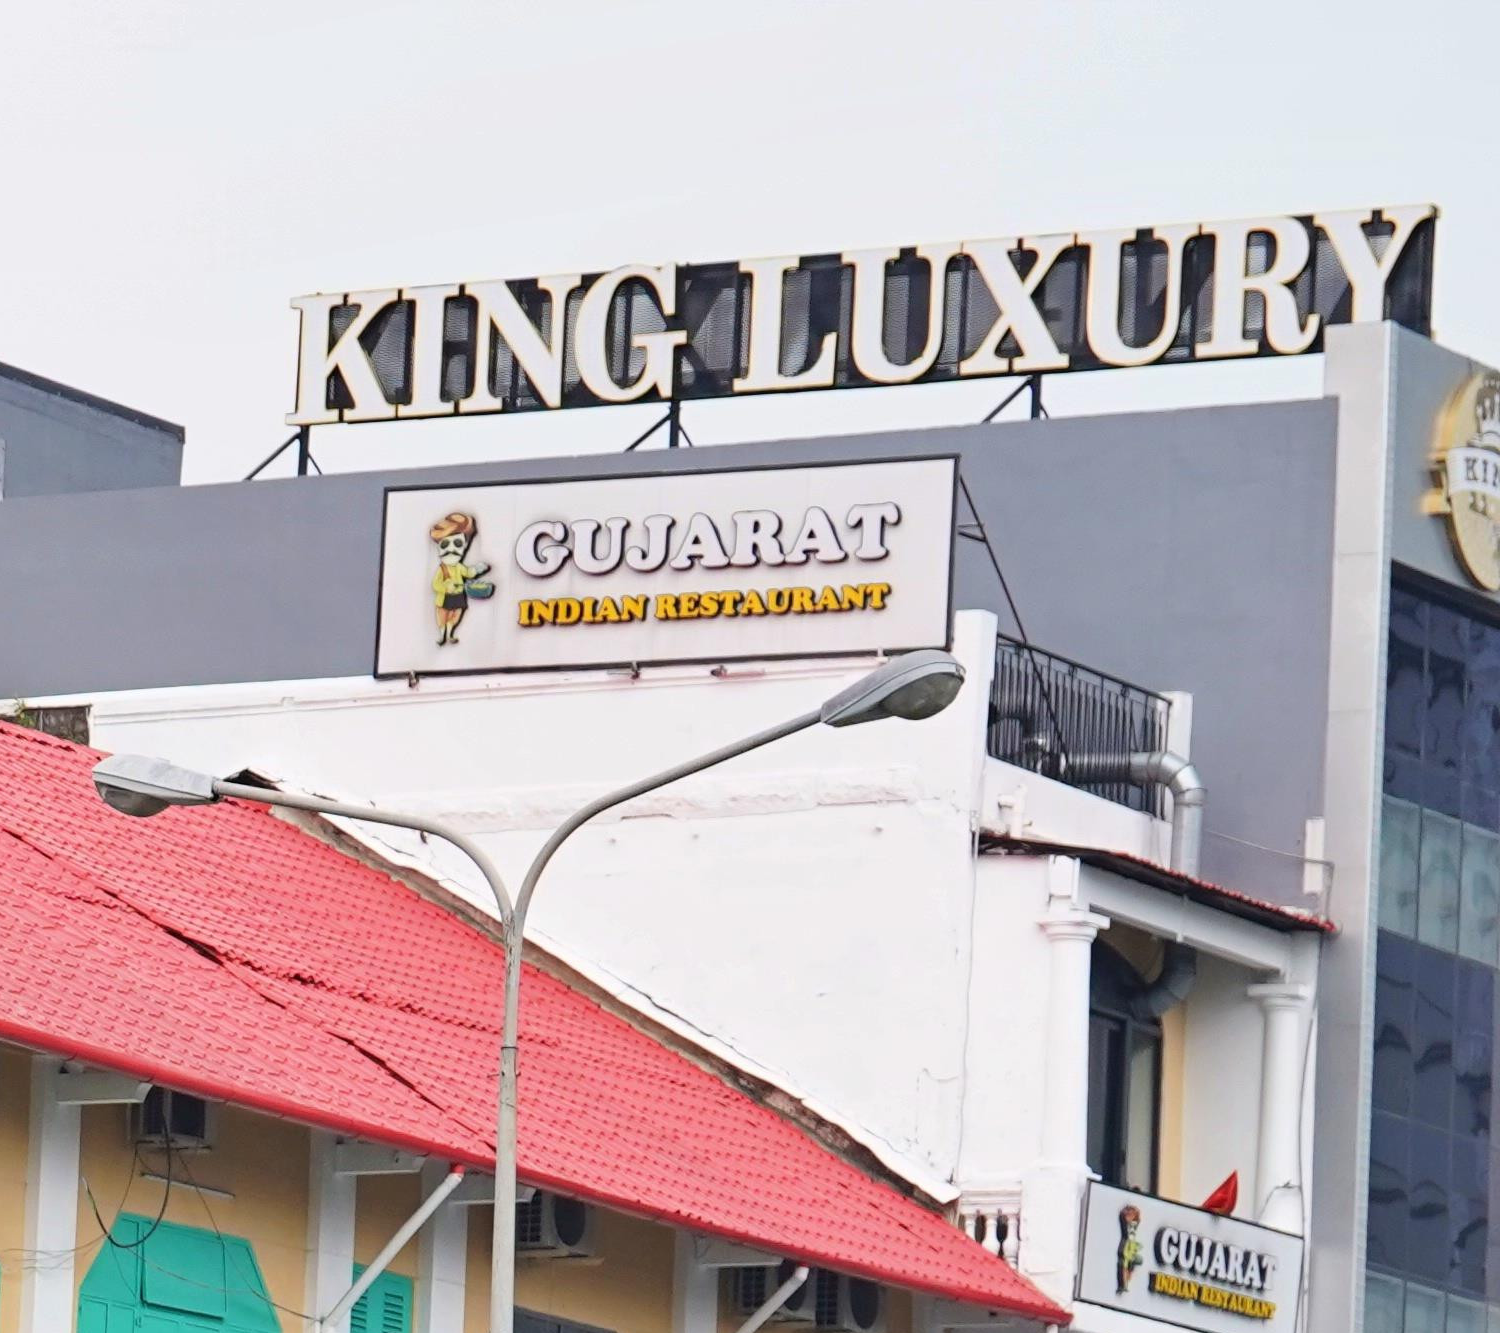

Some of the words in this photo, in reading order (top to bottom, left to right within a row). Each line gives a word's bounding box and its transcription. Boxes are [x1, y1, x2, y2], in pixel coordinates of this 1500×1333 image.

[286, 262, 690, 427] KING
[733, 203, 1437, 395] LUXURY
[513, 500, 904, 577] GUJARAT
[517, 592, 649, 629] INDIAN
[654, 581, 891, 621] RESTAURANT
[1154, 1227, 1279, 1292] GUJARAT
[1149, 1272, 1196, 1301] INDIAN
[1199, 1279, 1277, 1320] RESTAURANT
